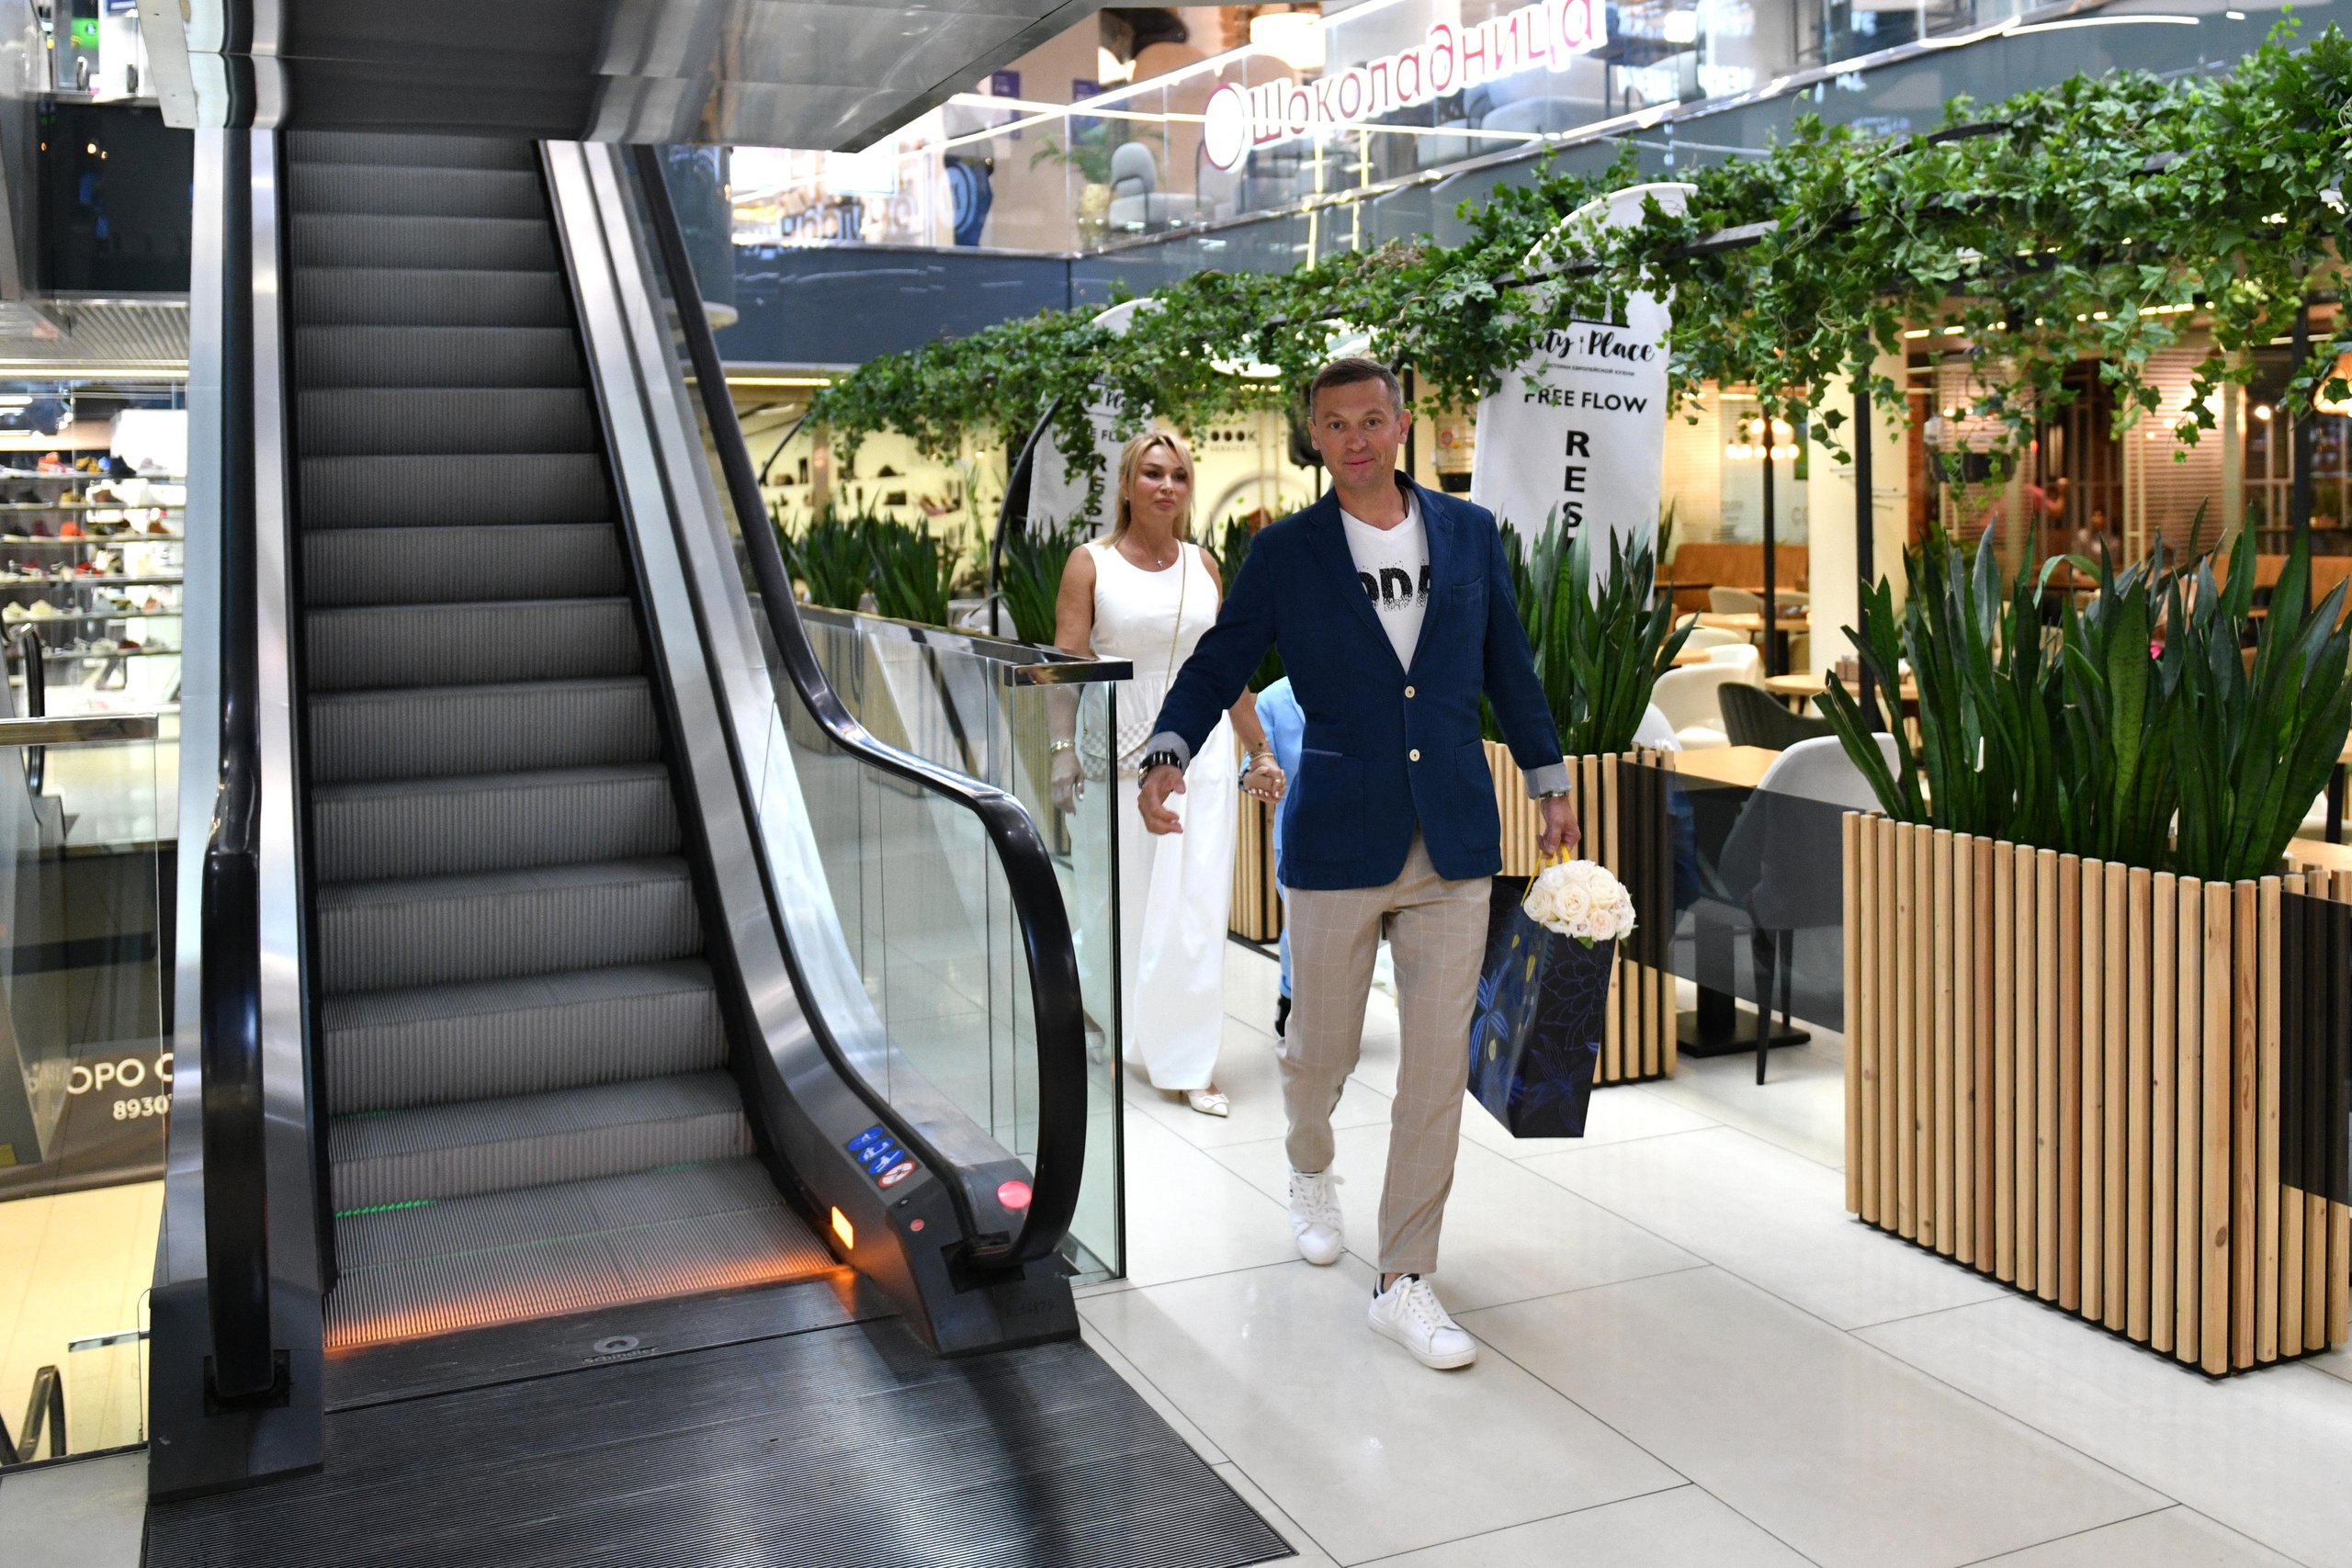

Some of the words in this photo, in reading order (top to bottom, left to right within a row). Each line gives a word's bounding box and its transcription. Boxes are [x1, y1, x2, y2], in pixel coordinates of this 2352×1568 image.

[1588, 330, 1655, 362] Place
[1524, 388, 1575, 407] FREE
[1581, 391, 1647, 413] FLOW
[1563, 429, 1590, 551] RES
[113, 1093, 173, 1121] 8930
